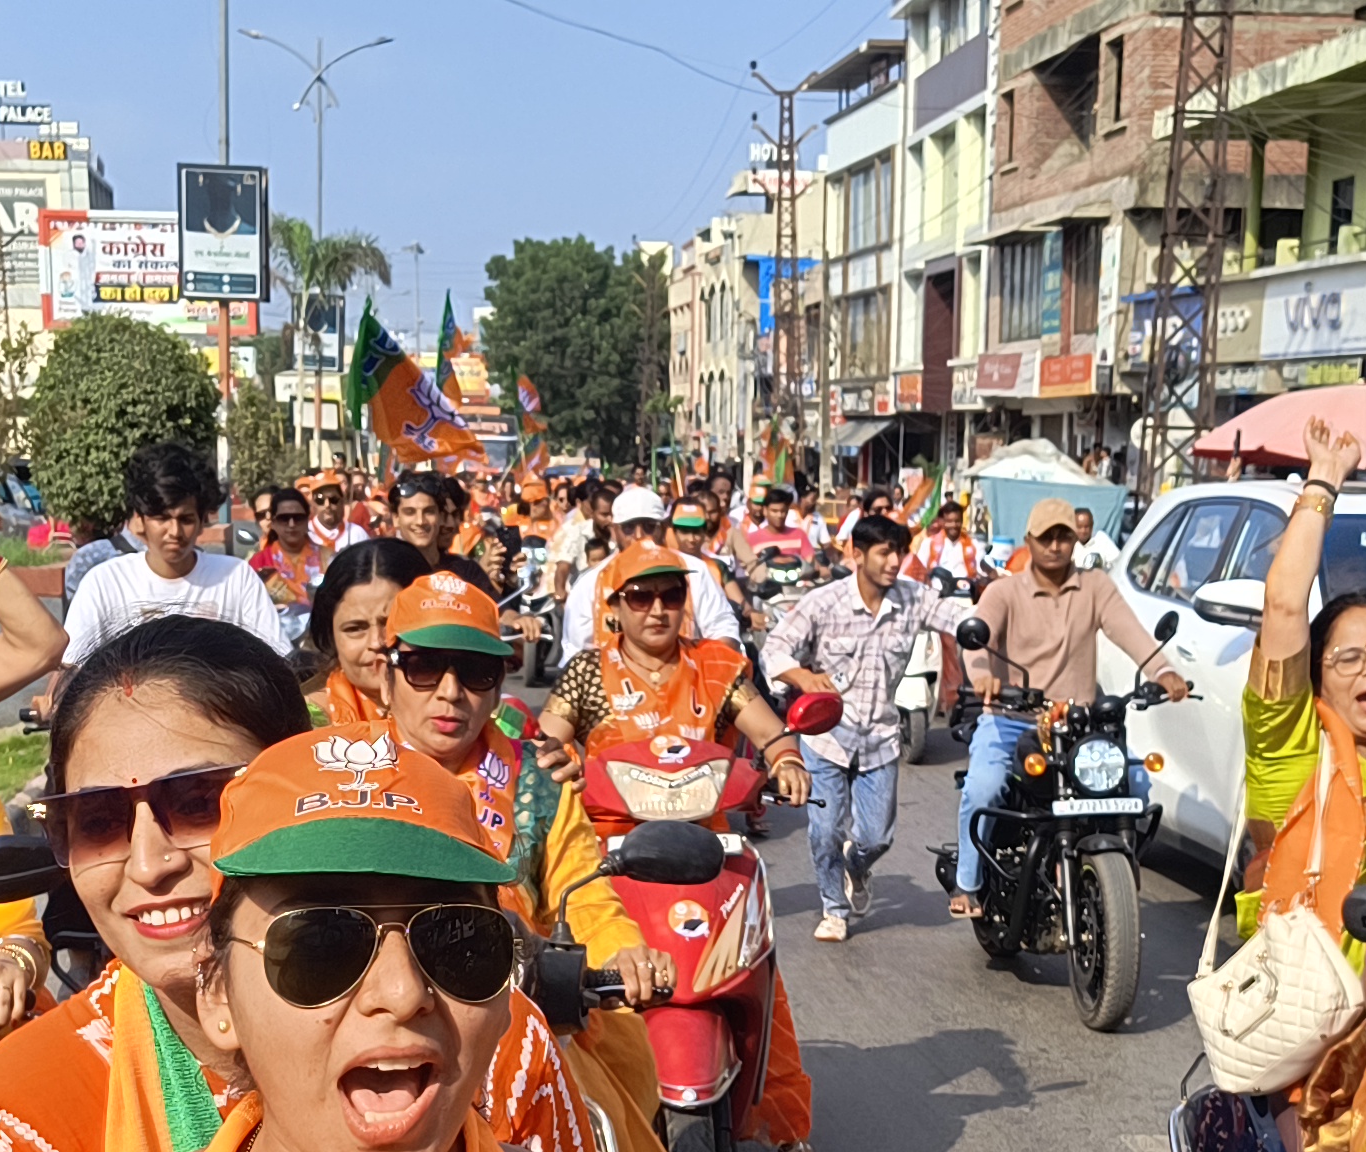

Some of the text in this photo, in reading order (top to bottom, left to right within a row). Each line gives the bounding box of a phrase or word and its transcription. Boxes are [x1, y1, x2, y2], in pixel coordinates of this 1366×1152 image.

[0, 105, 52, 122] PALACE
[29, 141, 65, 159] BAR
[750, 143, 799, 161] HOT
[100, 235, 165, 258] कांग्रेस
[295, 790, 423, 817] B.J.P.
[478, 808, 505, 829] JP
